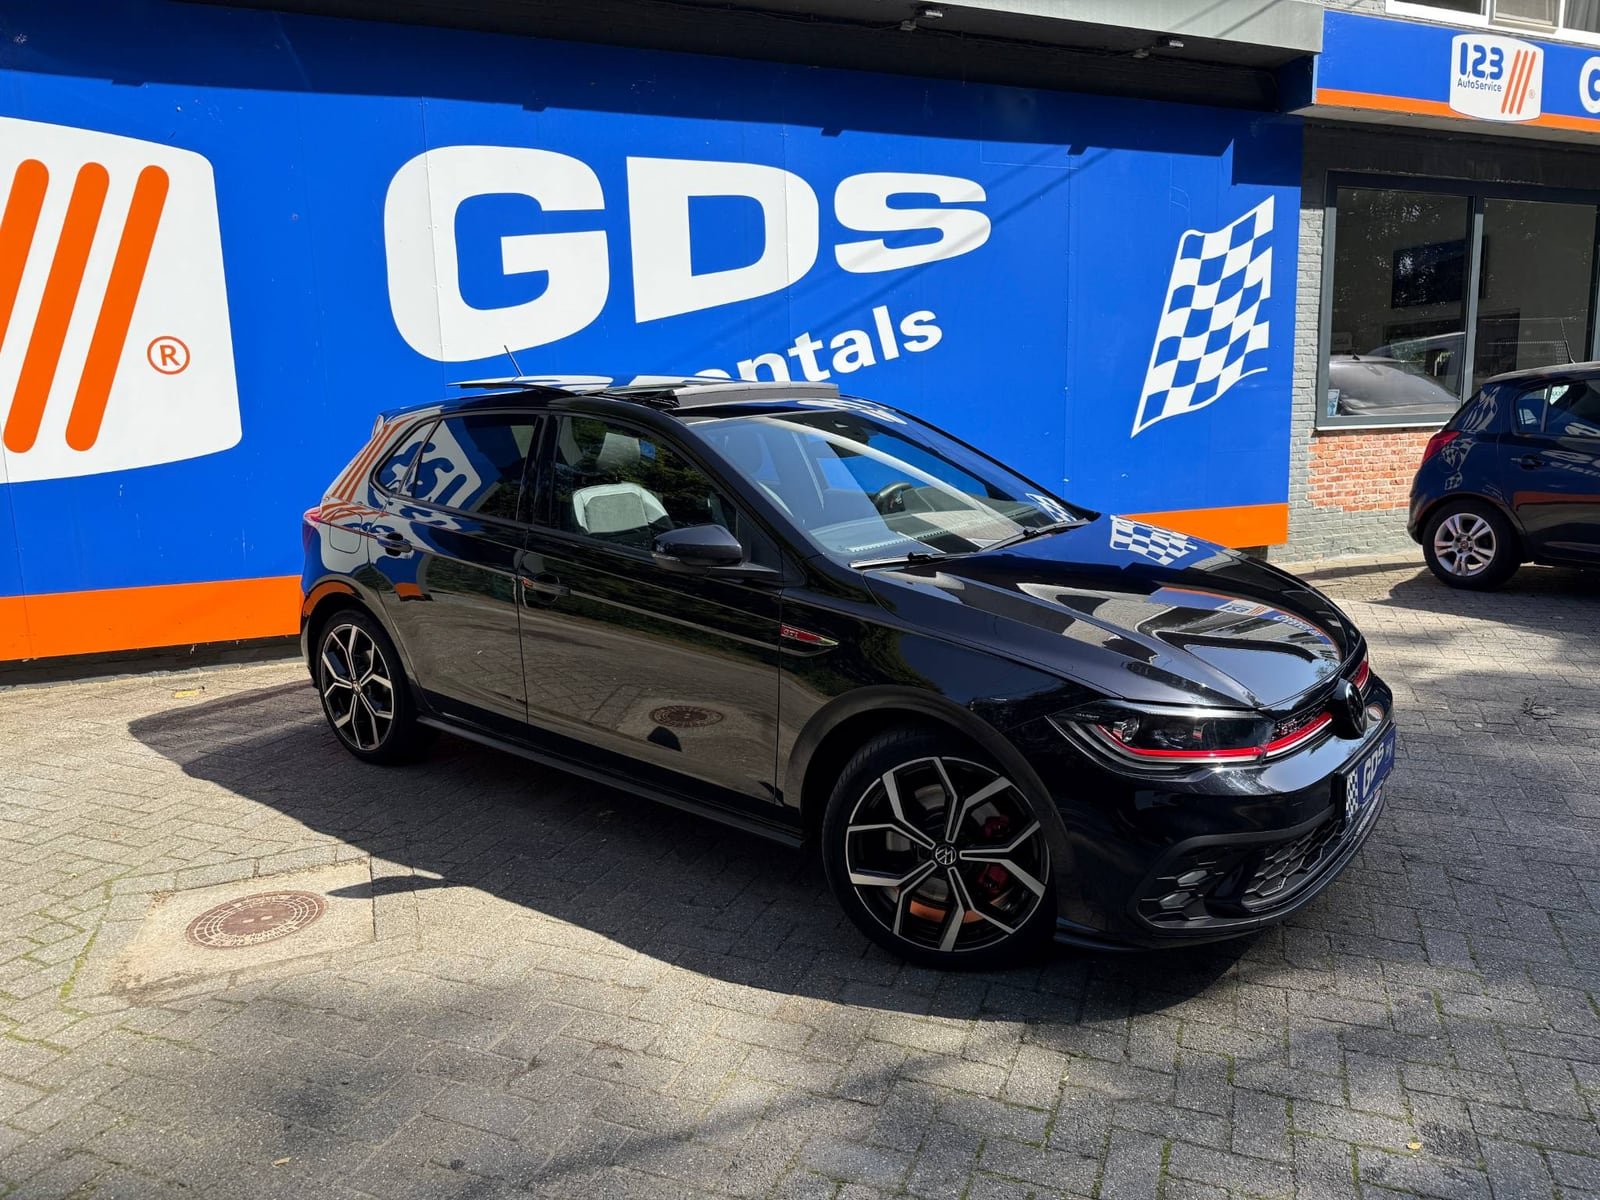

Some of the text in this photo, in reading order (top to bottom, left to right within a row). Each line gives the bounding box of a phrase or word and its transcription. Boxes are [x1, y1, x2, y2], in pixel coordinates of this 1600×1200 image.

[1457, 78, 1502, 92] AutoService
[384, 145, 992, 362] GDS
[1362, 742, 1384, 799] GDS
